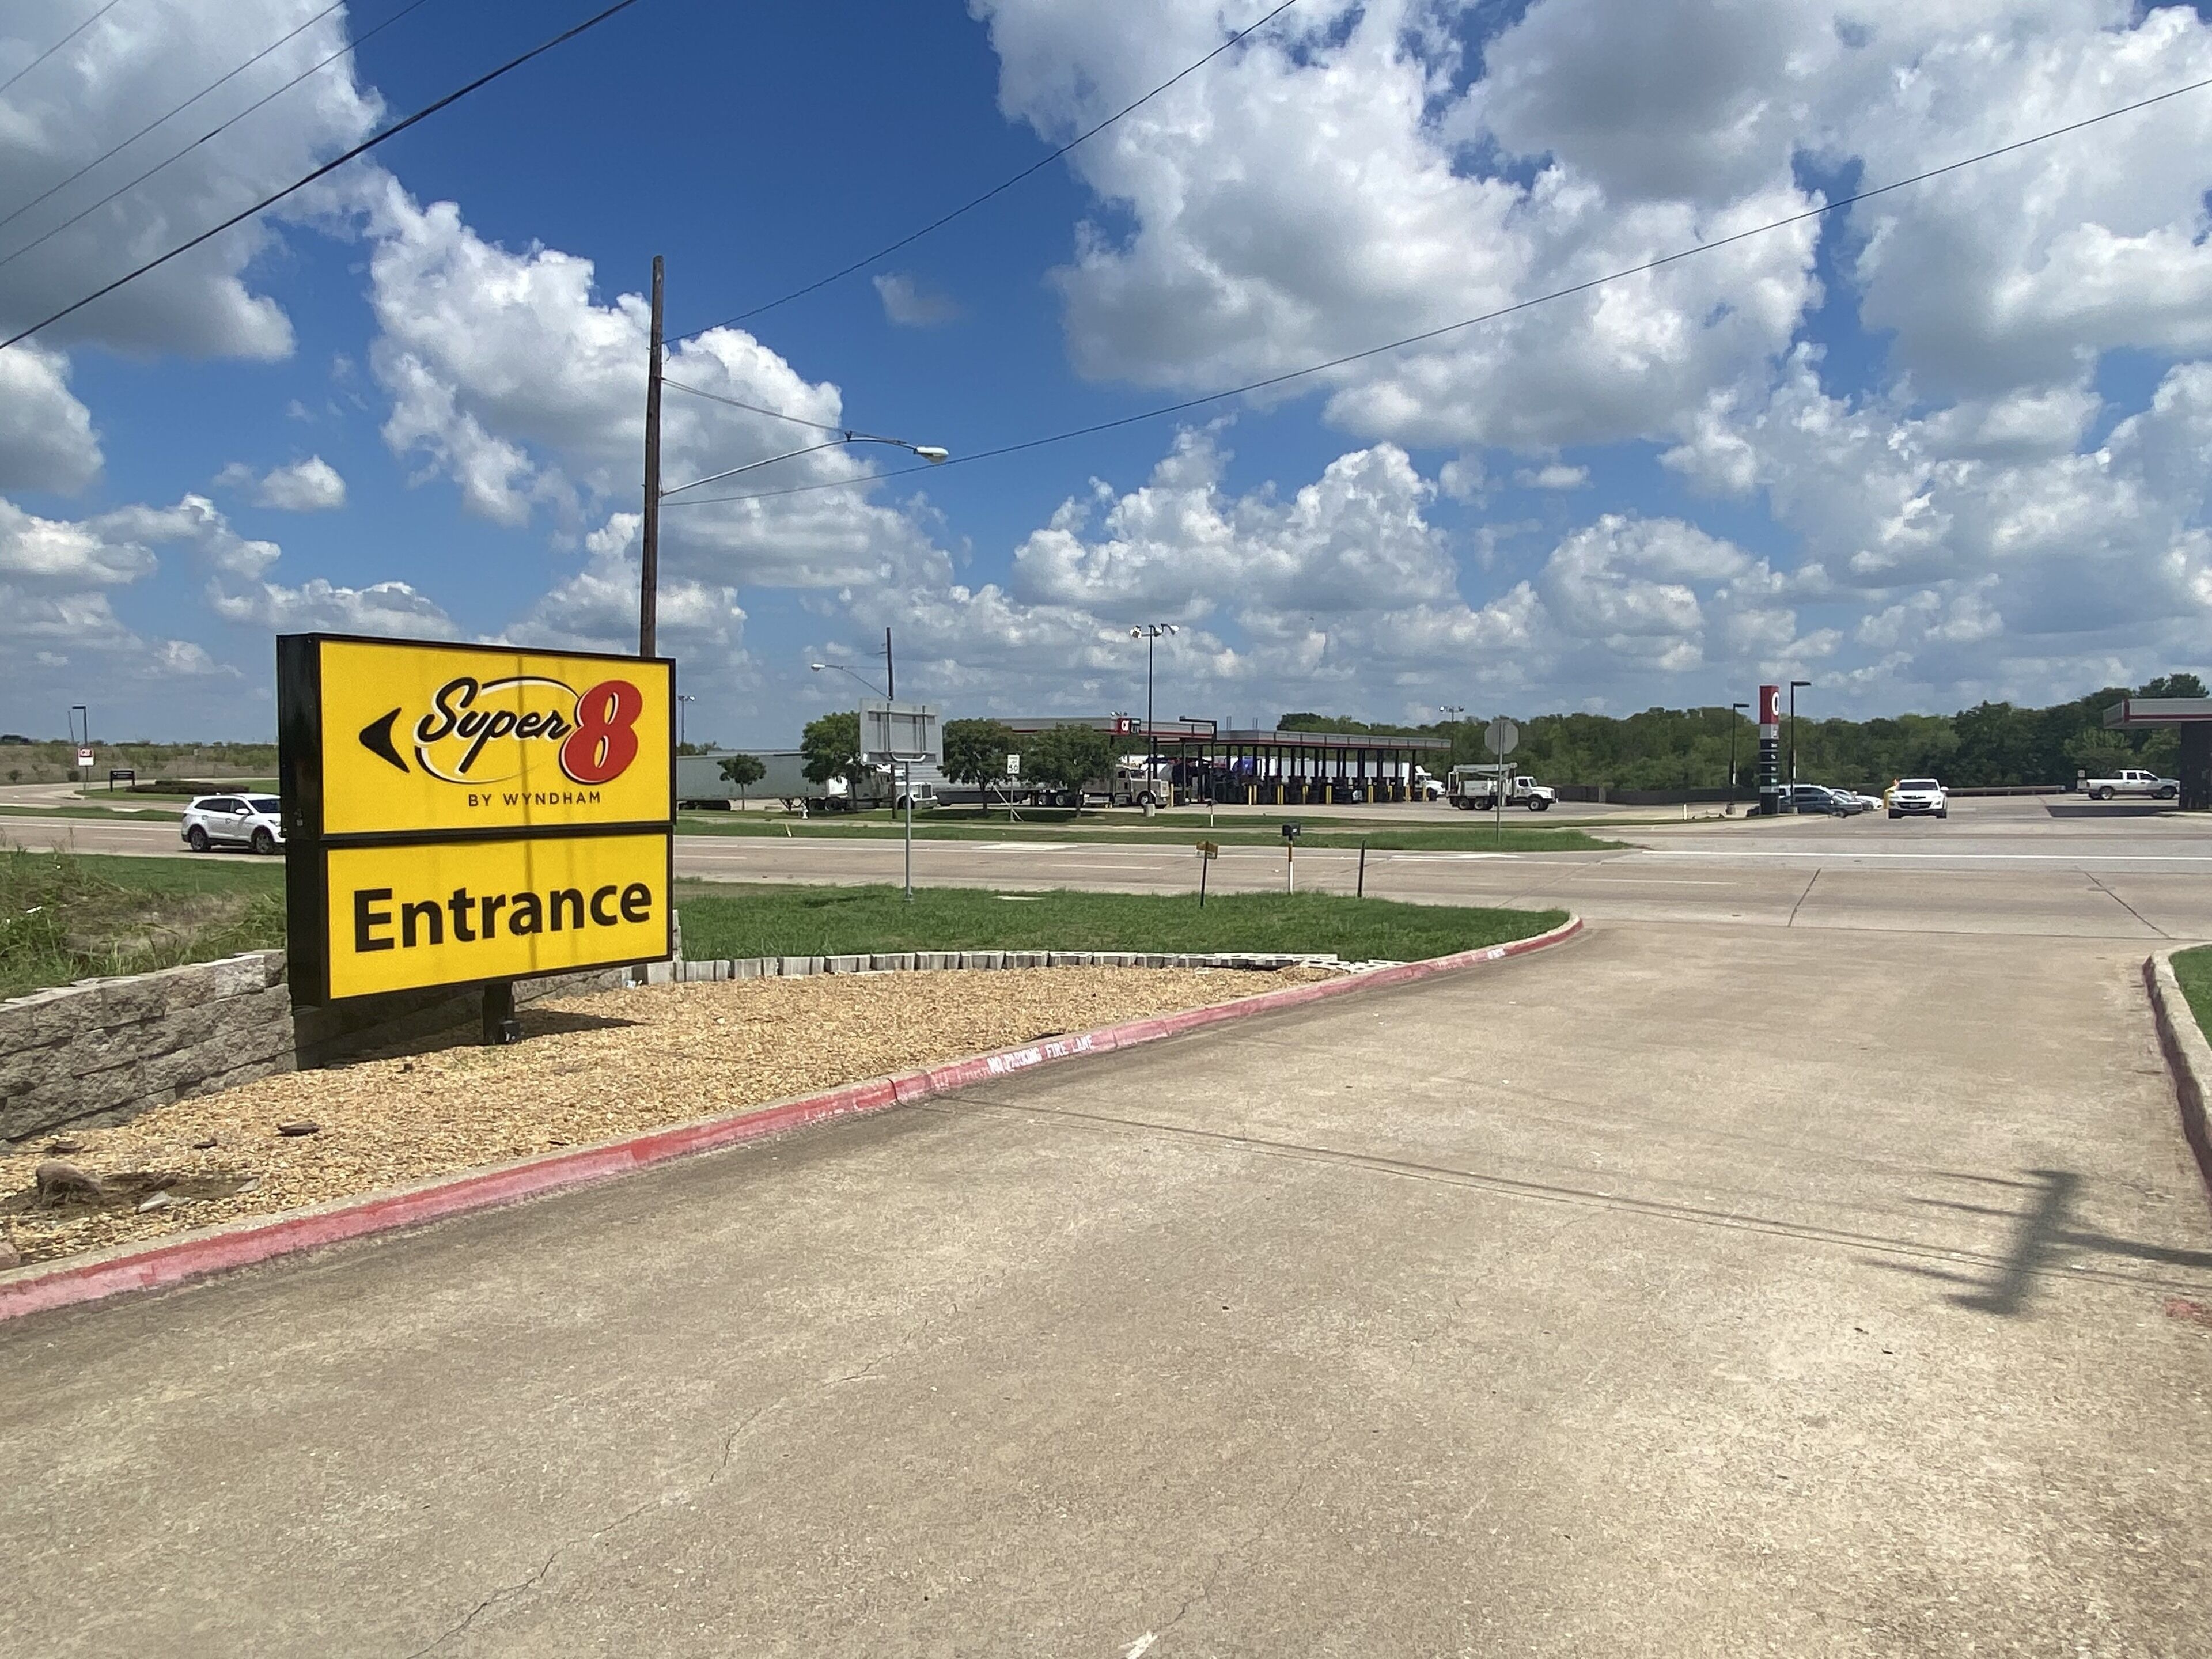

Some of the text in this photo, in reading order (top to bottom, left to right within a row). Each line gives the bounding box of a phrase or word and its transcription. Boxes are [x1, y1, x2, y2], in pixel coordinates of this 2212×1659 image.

[414, 676, 643, 785] Super 8
[468, 791, 601, 807] BY WYNDHAM
[353, 882, 652, 953] Entrance
[987, 1035, 1096, 1073] NO PARKING FIRE LANE
